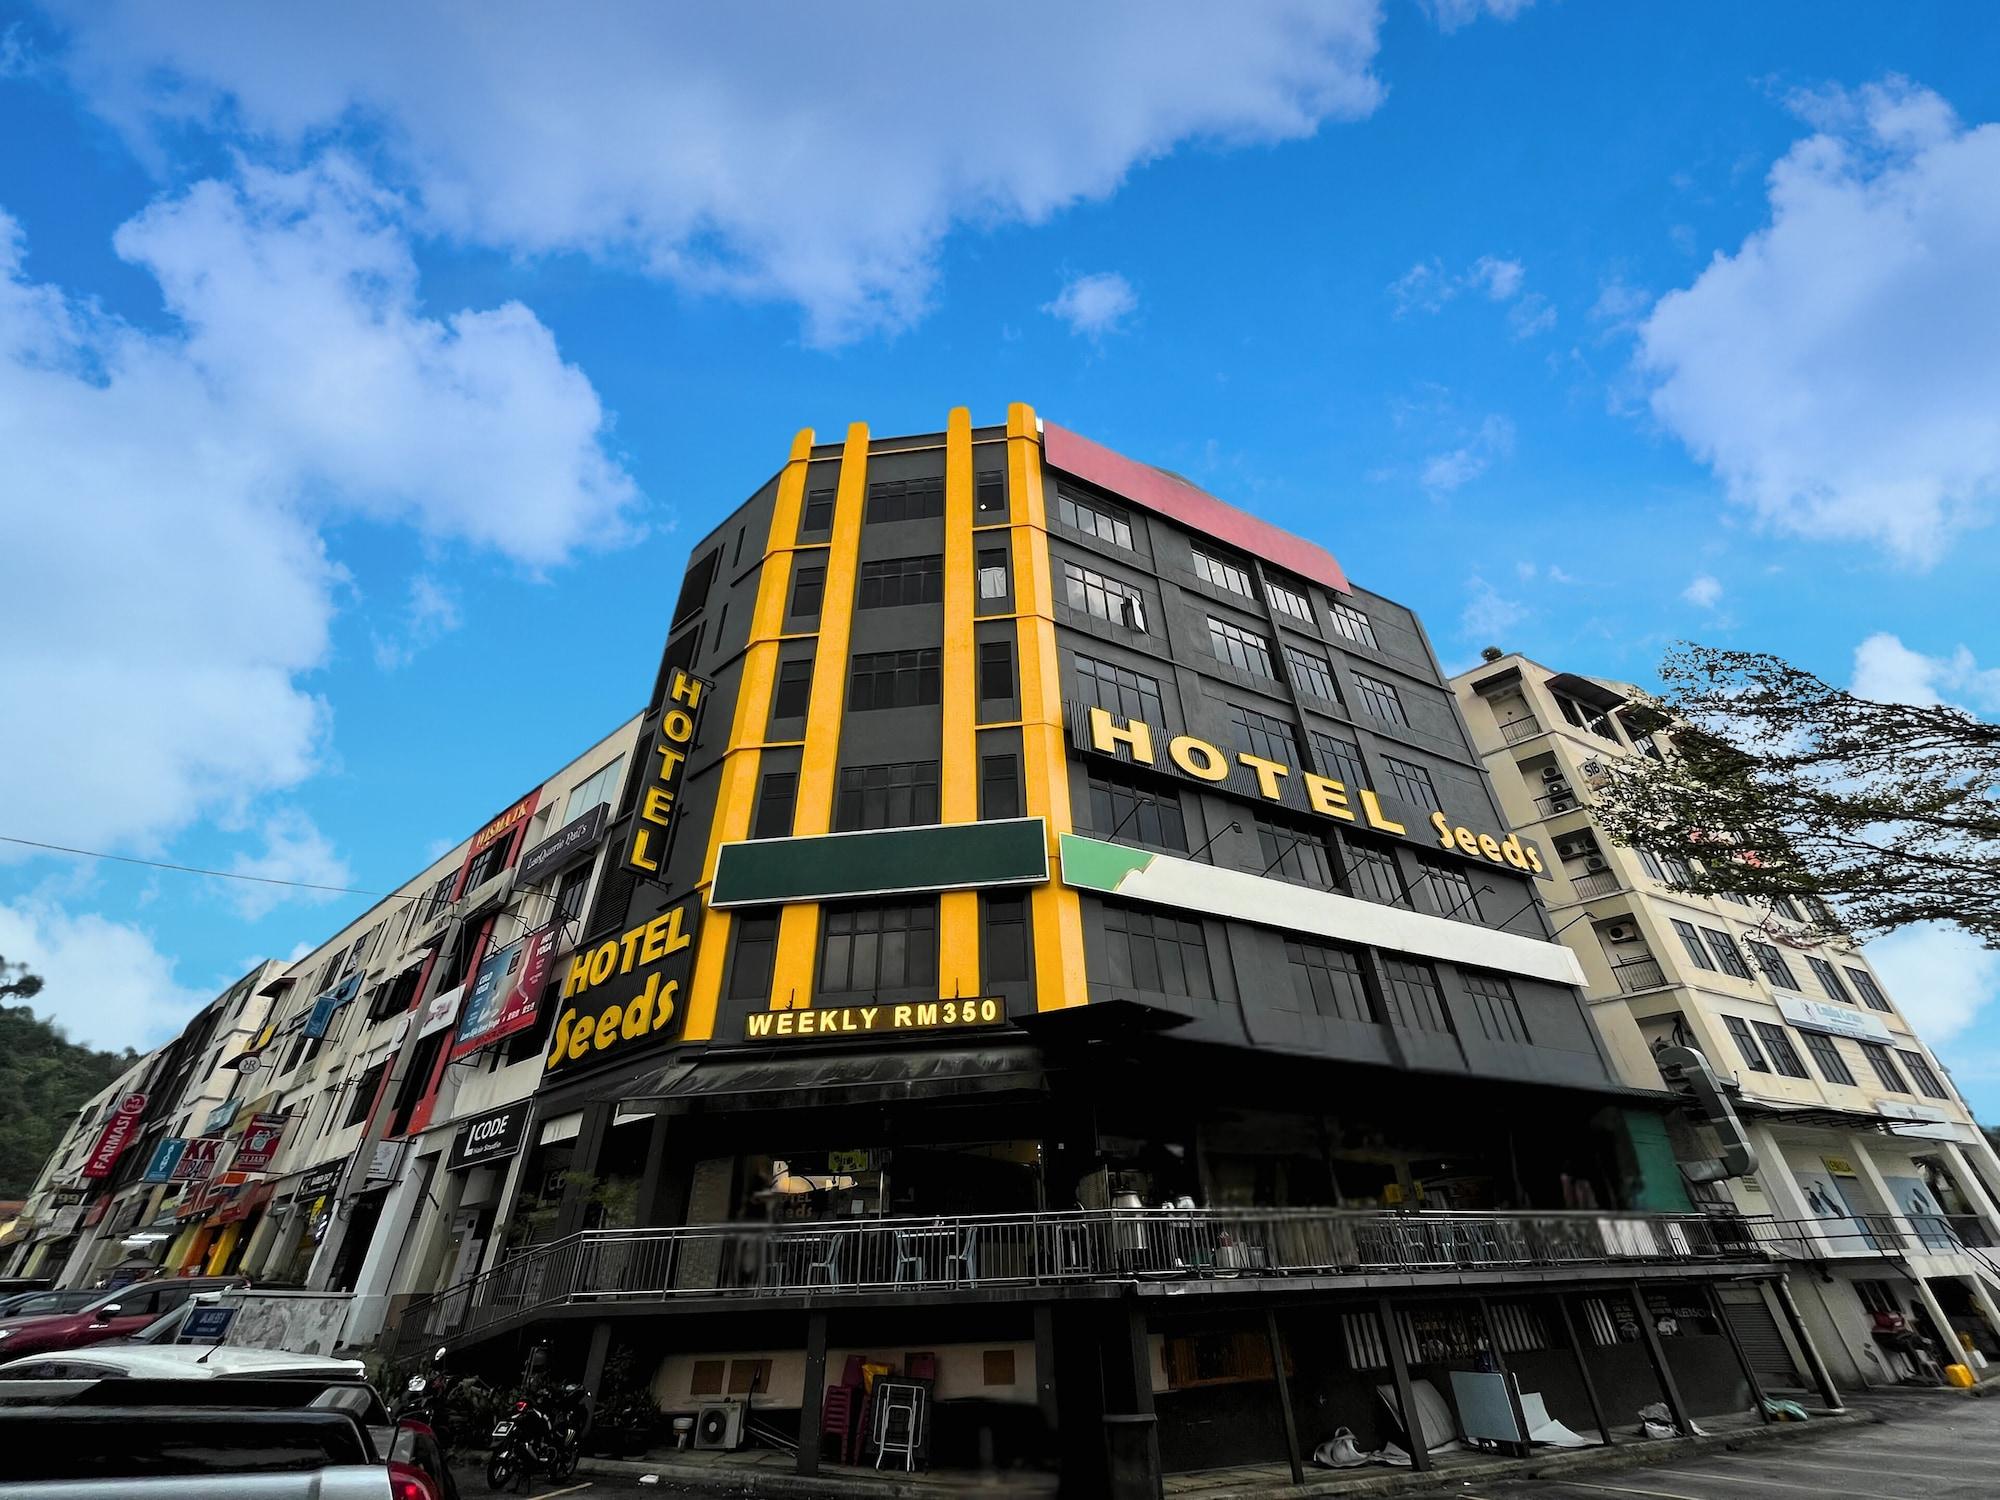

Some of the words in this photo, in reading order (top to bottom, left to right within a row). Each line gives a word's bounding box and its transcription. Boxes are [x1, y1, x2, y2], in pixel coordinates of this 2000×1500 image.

[630, 671, 702, 872] HOTEL
[1090, 707, 1406, 835] HOTEL
[1430, 811, 1543, 873] Seeds
[563, 907, 691, 998] HOTEL
[548, 971, 679, 1069] Seeds
[749, 1007, 878, 1036] WEEKLY
[894, 1000, 996, 1028] RM350
[93, 1116, 133, 1170] FARMASI
[184, 1140, 222, 1160] KK
